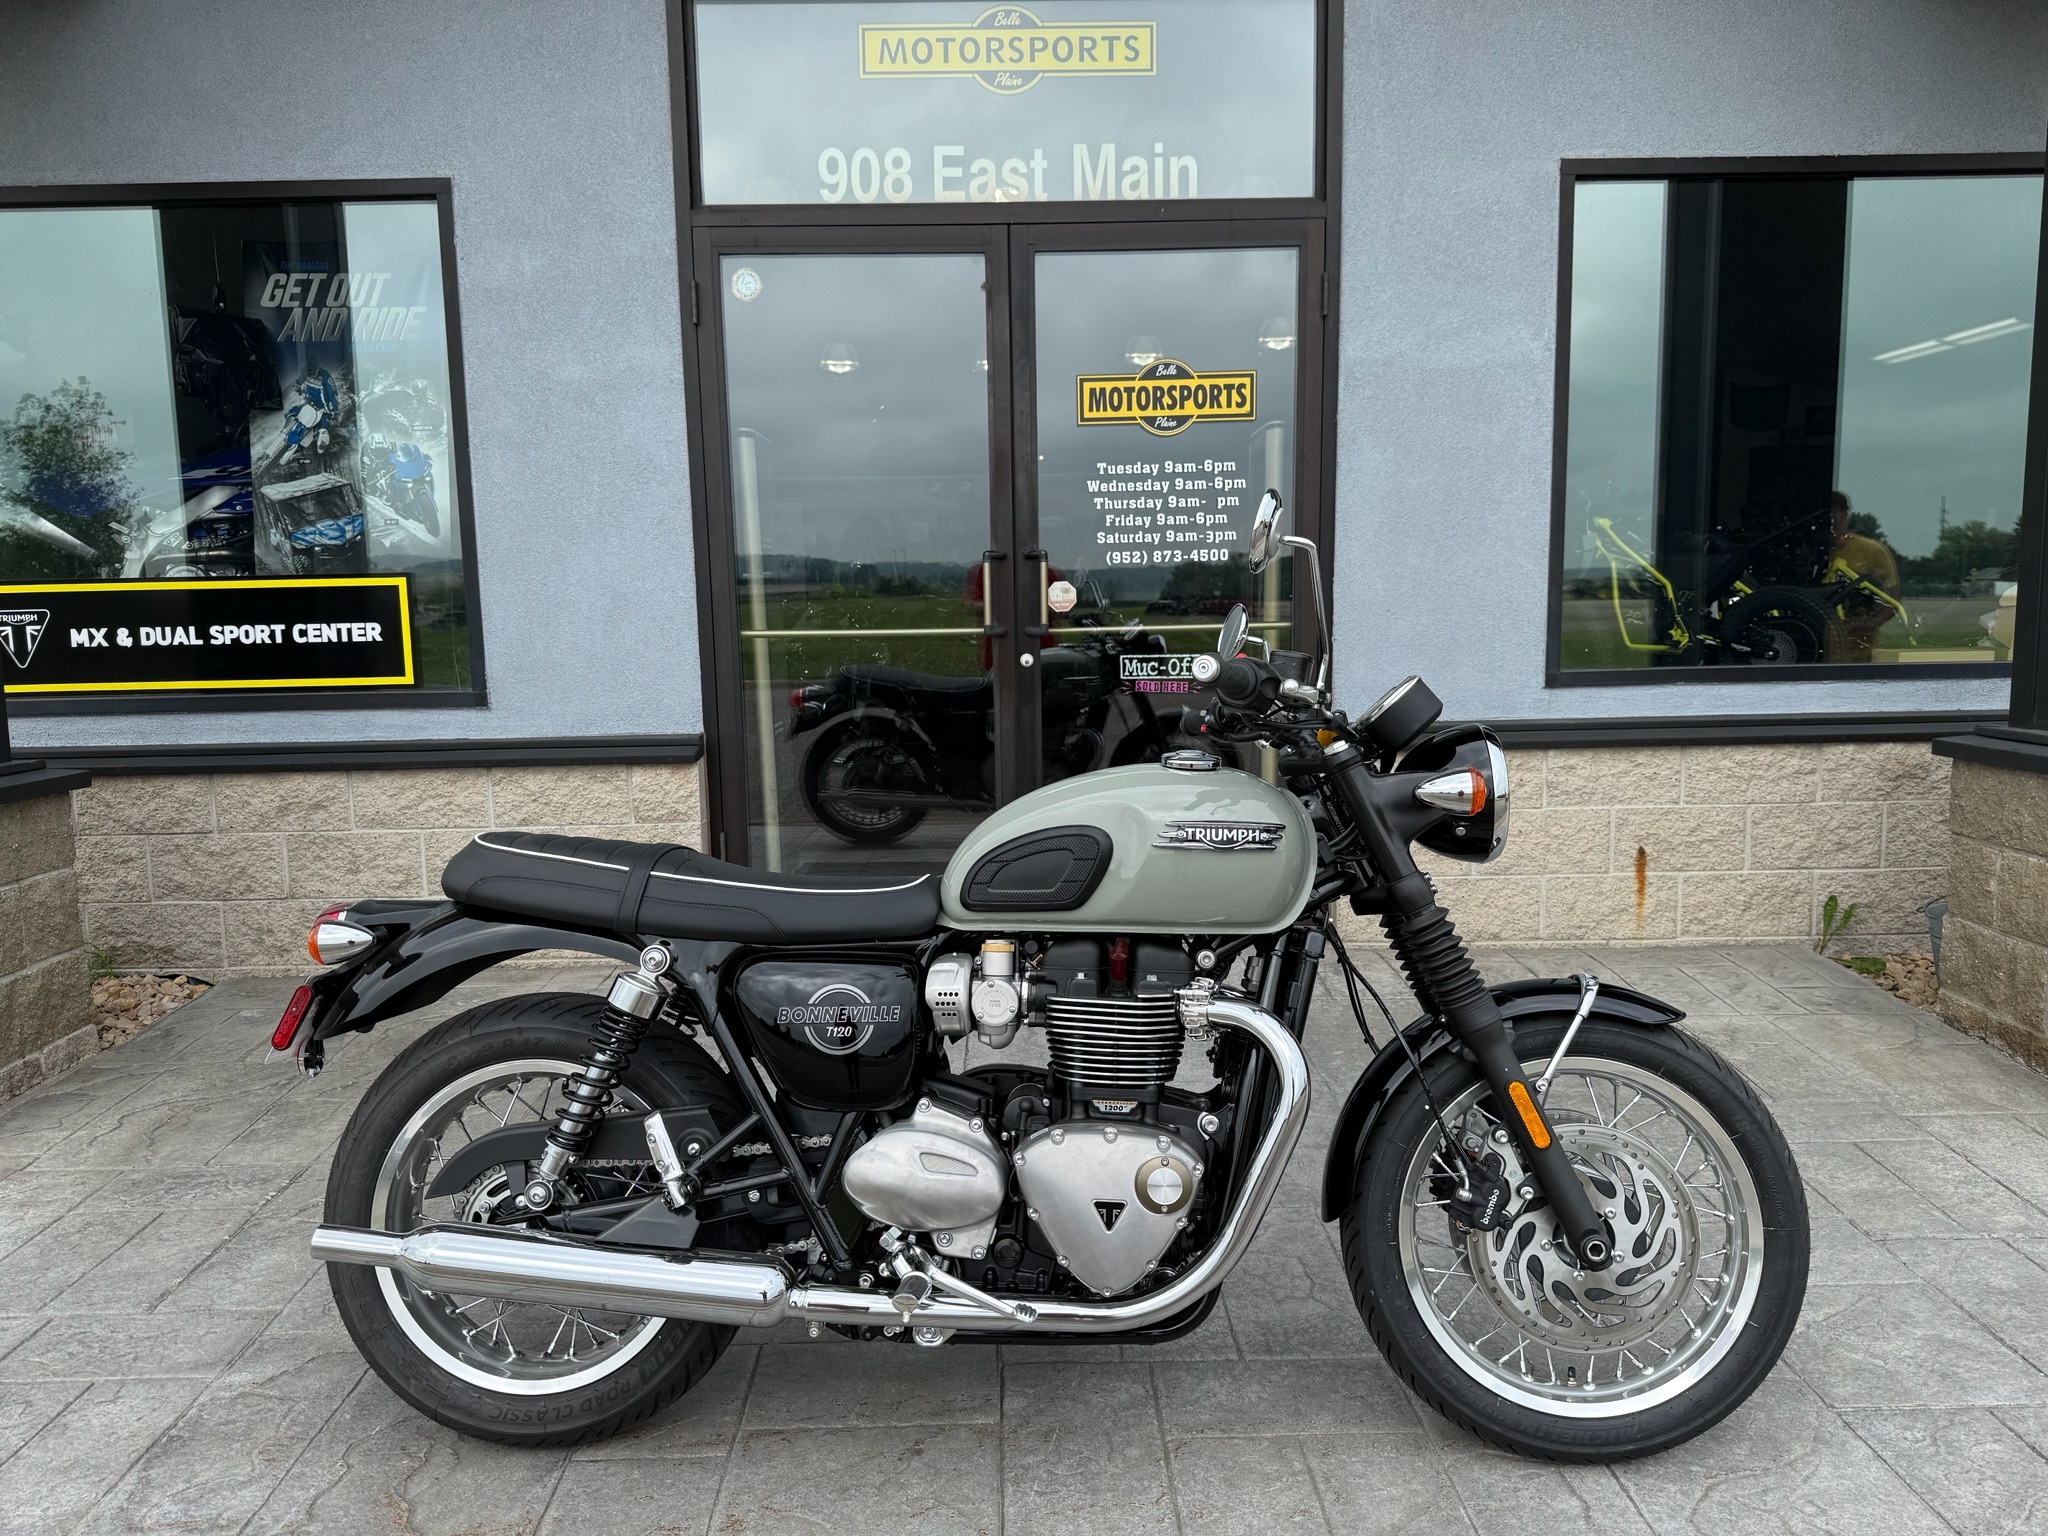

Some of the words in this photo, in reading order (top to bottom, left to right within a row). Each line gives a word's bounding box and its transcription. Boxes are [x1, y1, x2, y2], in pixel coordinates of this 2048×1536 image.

[992, 11, 1022, 26] Belle
[877, 35, 1142, 65] MOTORSPORTS
[993, 72, 1023, 88] Plaine
[817, 146, 913, 204] 908
[933, 144, 1048, 203] East
[1072, 142, 1199, 201] Main
[260, 272, 328, 308] GET
[326, 272, 392, 308] OUT
[277, 307, 349, 342] AND
[351, 306, 428, 342] RIDE
[1155, 364, 1178, 377] Belle
[1088, 383, 1247, 412] MOTORSPORTS
[1154, 416, 1178, 428] Plaine
[1096, 462, 1160, 477] Tuesday
[1163, 459, 1236, 475] 9am-6pm
[1086, 479, 1170, 494] Wednesday
[1174, 477, 1247, 492] 9am-6pm
[1093, 497, 1163, 511] Thursday
[1216, 495, 1240, 510] pm
[1105, 514, 1152, 529] Friday
[1156, 512, 1228, 527] 9am-6pm
[1096, 531, 1161, 545] Saturday
[1165, 530, 1238, 544] 9am-3pm
[1105, 550, 1149, 566] (952)
[1152, 548, 1230, 564] 873-4500
[69, 627, 110, 648] MX
[116, 627, 134, 648] &
[139, 625, 204, 647] DUAL
[209, 623, 286, 645] SPORT
[292, 621, 384, 644] CENTER
[1123, 658, 1196, 676] Muc-Of
[1136, 681, 1160, 692] SOLD
[1163, 681, 1188, 692] HERE
[1184, 827, 1260, 844] TRIUMPH
[777, 1005, 901, 1024] BONNEVILLE
[825, 1026, 853, 1037] T120
[1104, 1104, 1124, 1112] 1200
[1479, 1188, 1500, 1225] brembo
[579, 1382, 632, 1413] ROAD
[488, 1404, 574, 1423] CLASSIC
